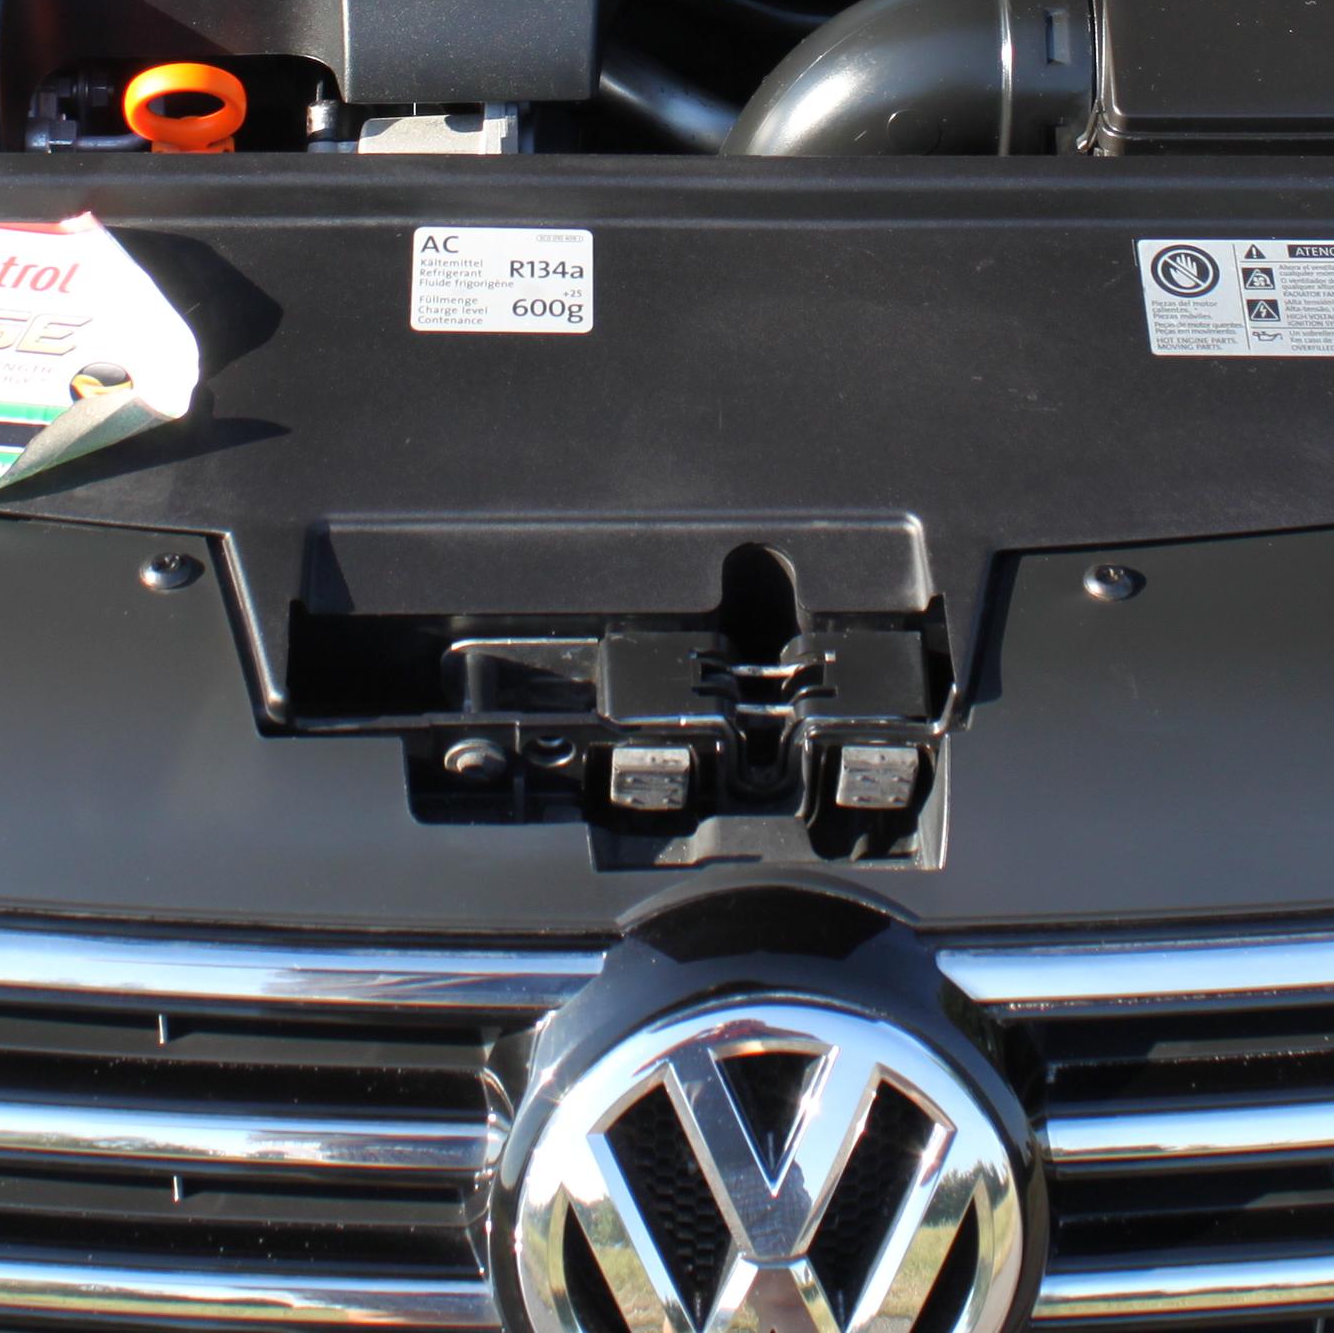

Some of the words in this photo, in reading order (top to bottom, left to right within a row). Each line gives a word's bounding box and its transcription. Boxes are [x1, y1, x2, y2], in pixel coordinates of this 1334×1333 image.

[421, 235, 460, 253] AC
[420, 258, 483, 268] Kältemittel
[420, 269, 482, 278] Refrigerant
[509, 260, 584, 279] R134a
[419, 279, 451, 288] Fluide
[455, 279, 514, 289] frigorigène
[419, 296, 478, 306] Füllmenge
[418, 306, 457, 315] Charge
[462, 306, 488, 315] level
[512, 299, 584, 324] 600g
[418, 316, 483, 325] Contenance
